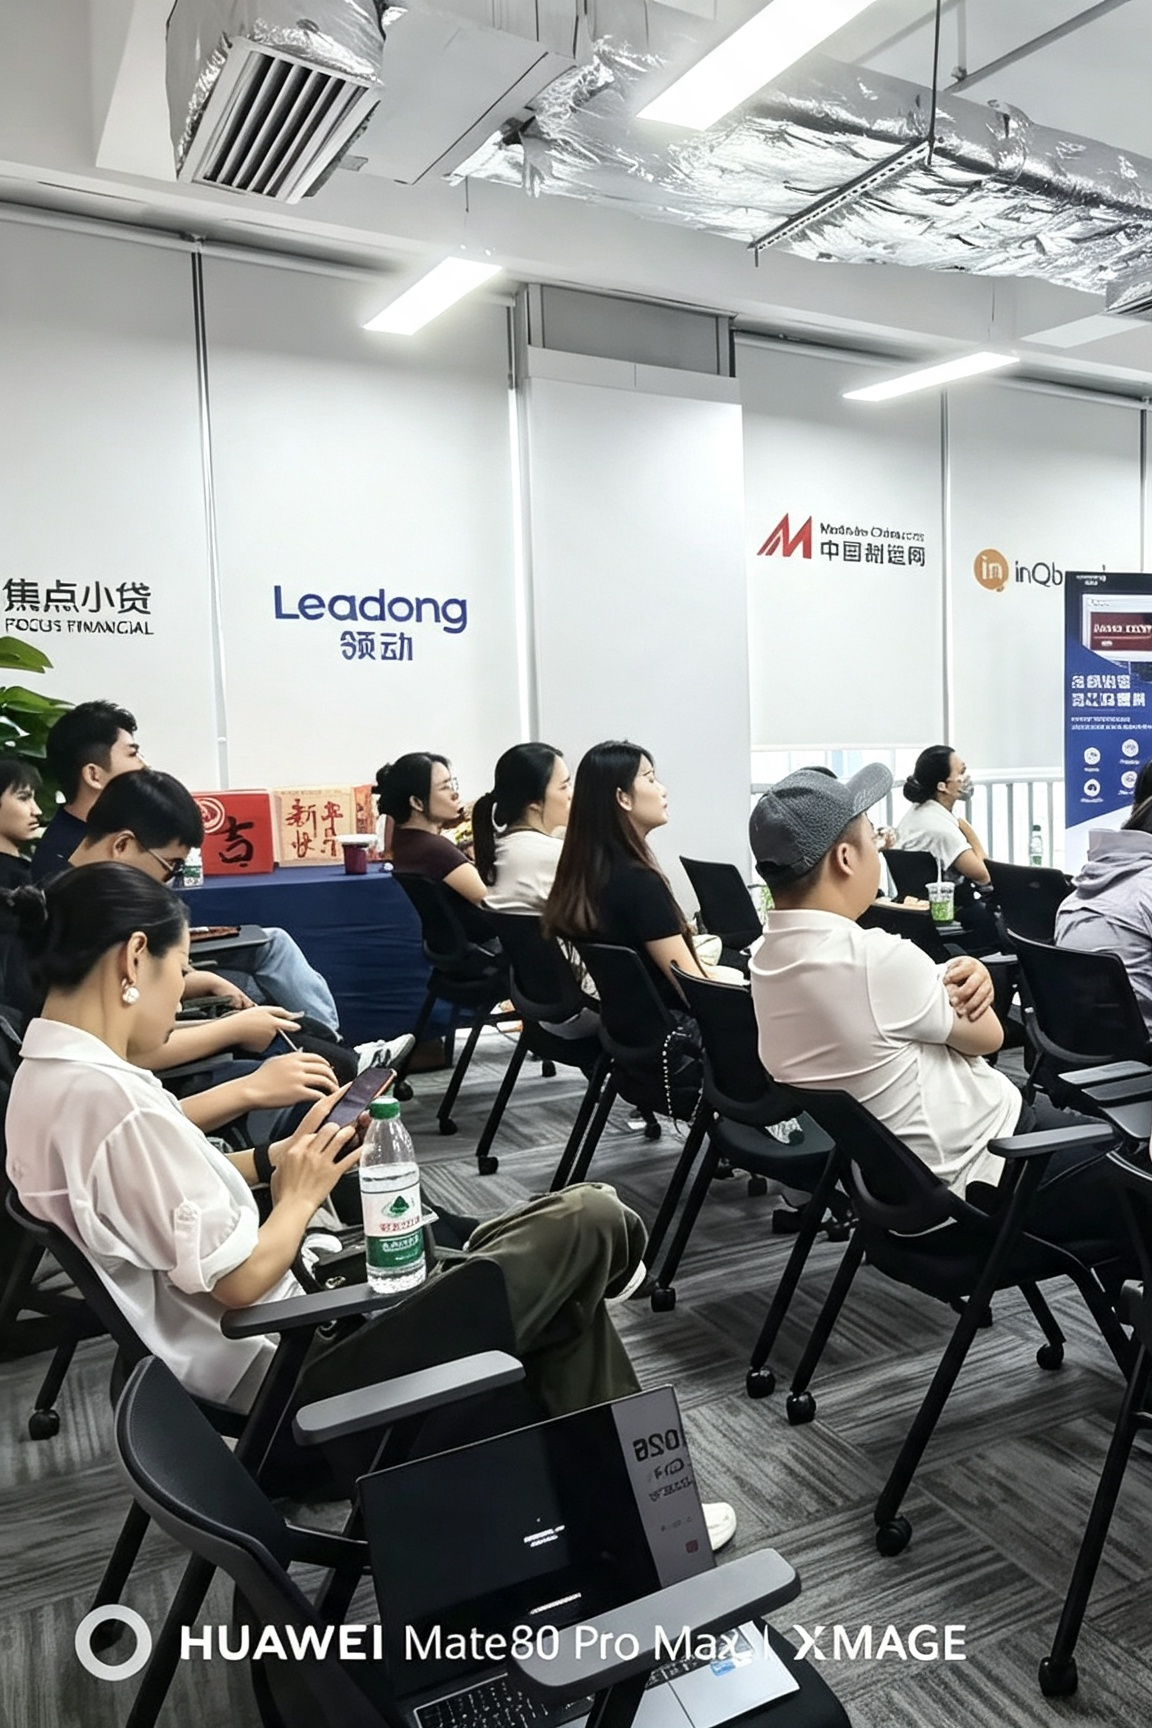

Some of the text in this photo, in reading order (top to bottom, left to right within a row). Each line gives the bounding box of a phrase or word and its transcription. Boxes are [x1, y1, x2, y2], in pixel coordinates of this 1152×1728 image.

[3, 578, 151, 614] 焦点小贷
[274, 585, 467, 634] Leadong
[5, 618, 155, 635] FOCUS FINANCIAL
[340, 630, 413, 660] 领动
